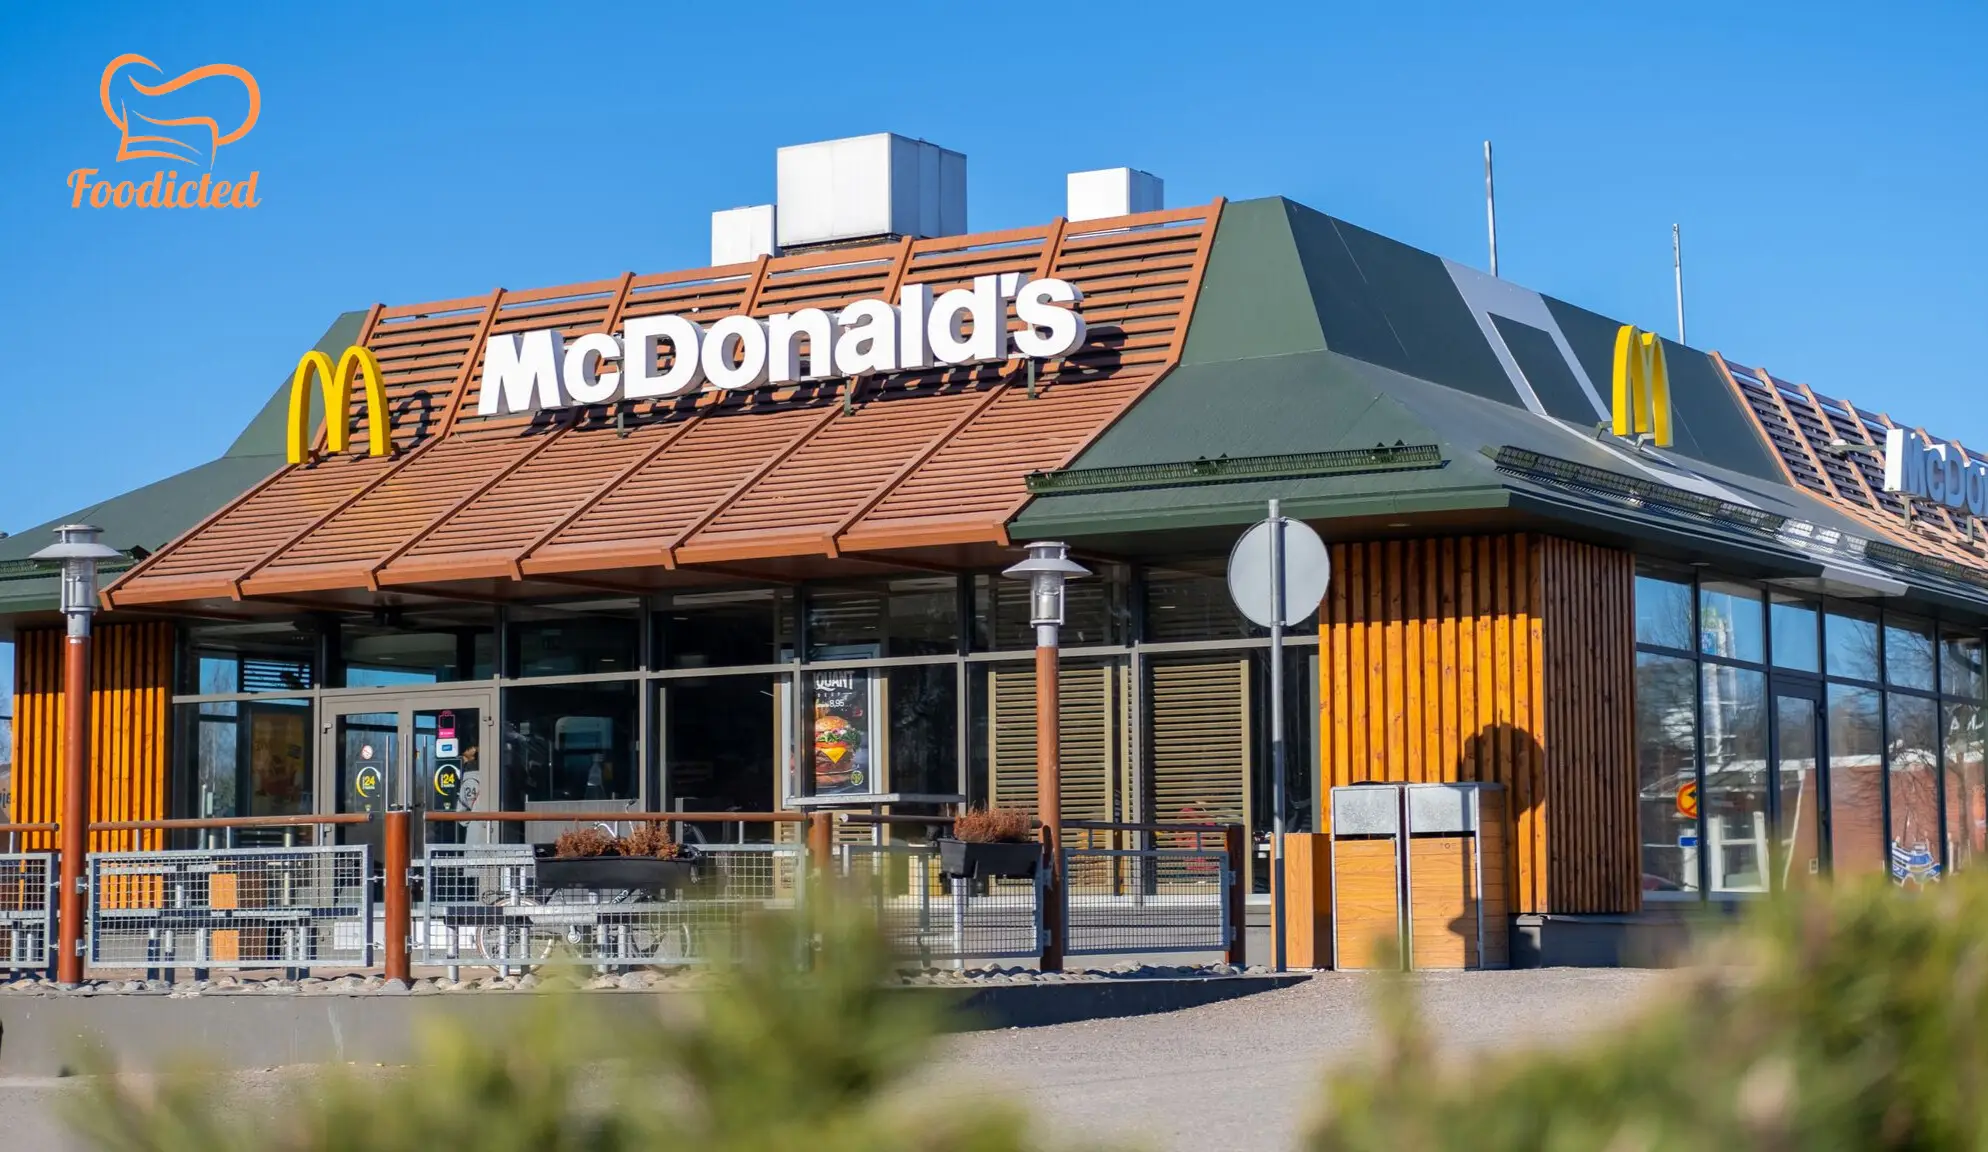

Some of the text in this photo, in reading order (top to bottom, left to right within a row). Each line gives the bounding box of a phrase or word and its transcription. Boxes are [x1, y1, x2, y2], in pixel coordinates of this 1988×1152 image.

[477, 273, 1085, 417] McDonald's
[1884, 429, 1988, 516] McDo
[365, 776, 375, 785] 24
[443, 774, 454, 784] 24
